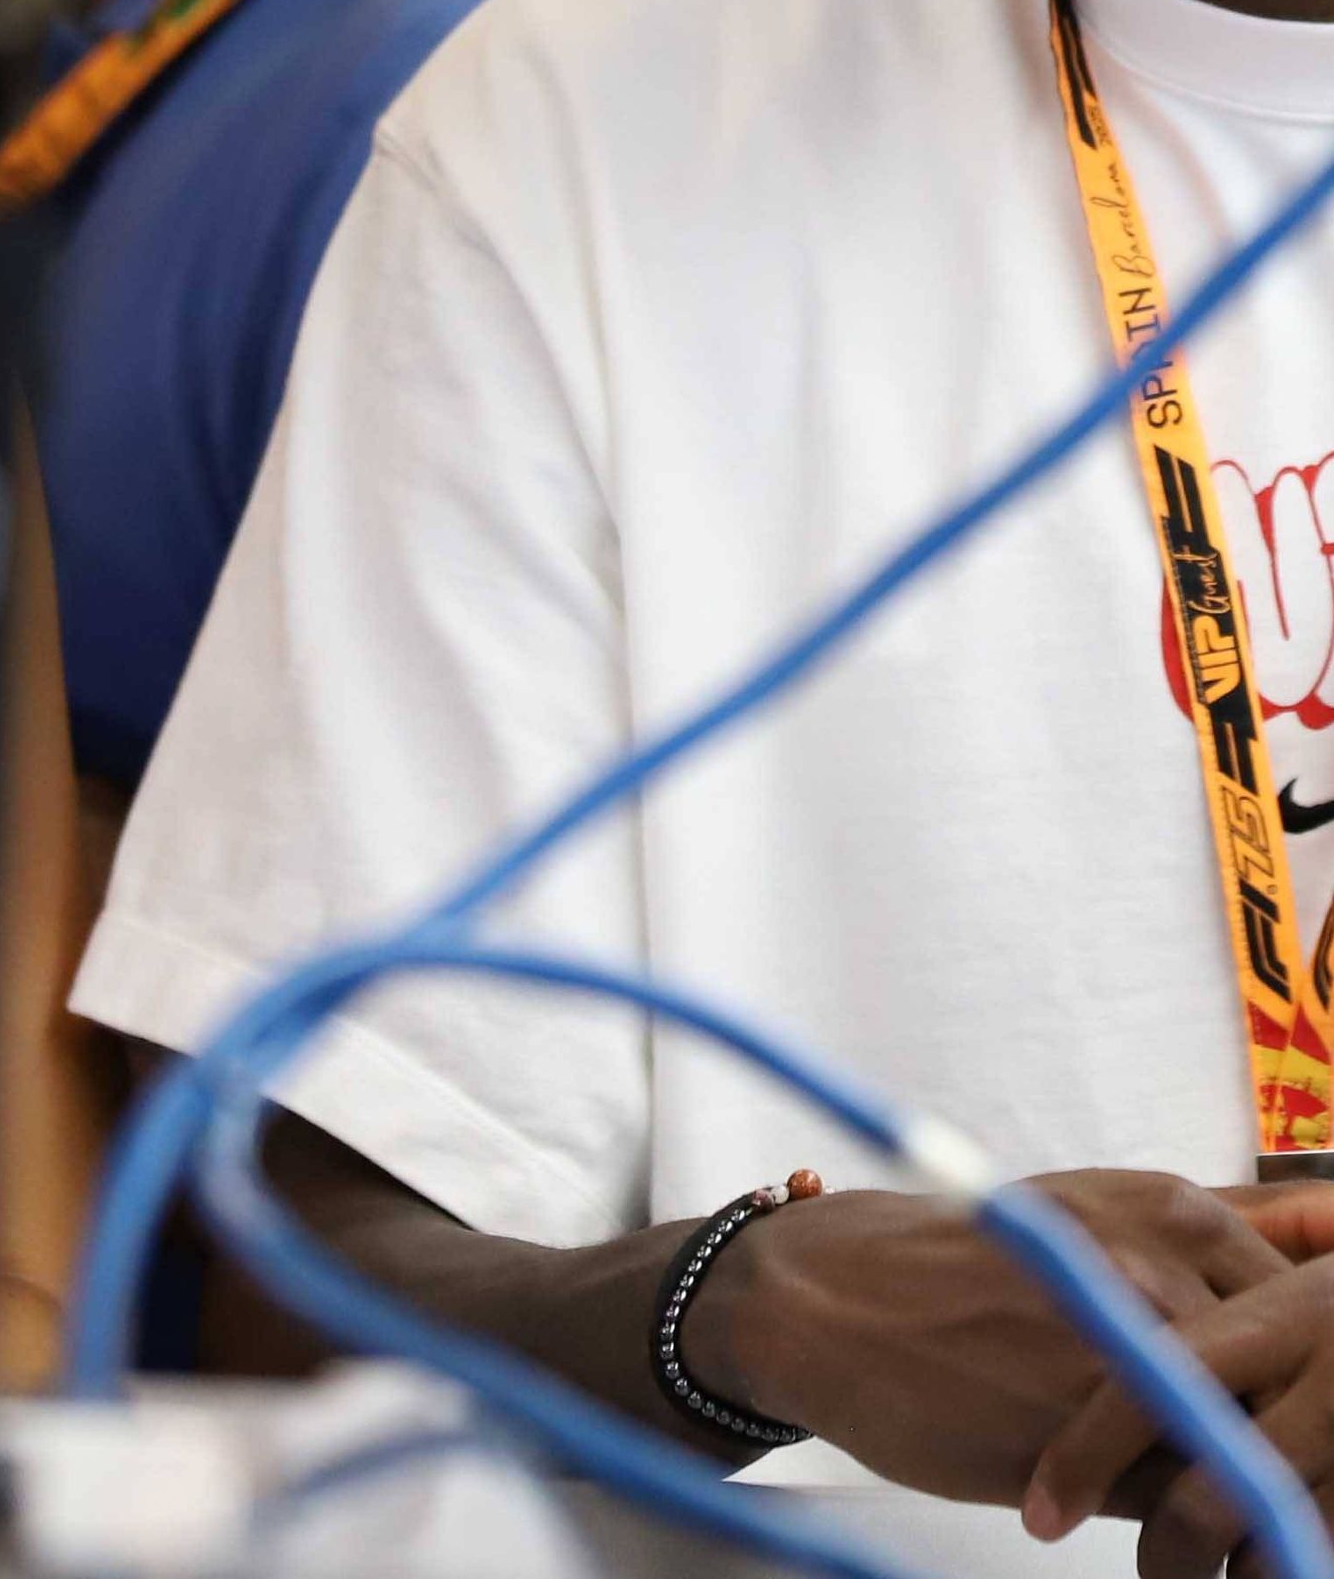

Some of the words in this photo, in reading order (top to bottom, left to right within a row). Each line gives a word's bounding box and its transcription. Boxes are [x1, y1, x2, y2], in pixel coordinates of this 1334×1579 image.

[1090, 162, 1155, 278] Barcelona
[1171, 544, 1229, 615] Guest
[1191, 614, 1240, 705] VIP
